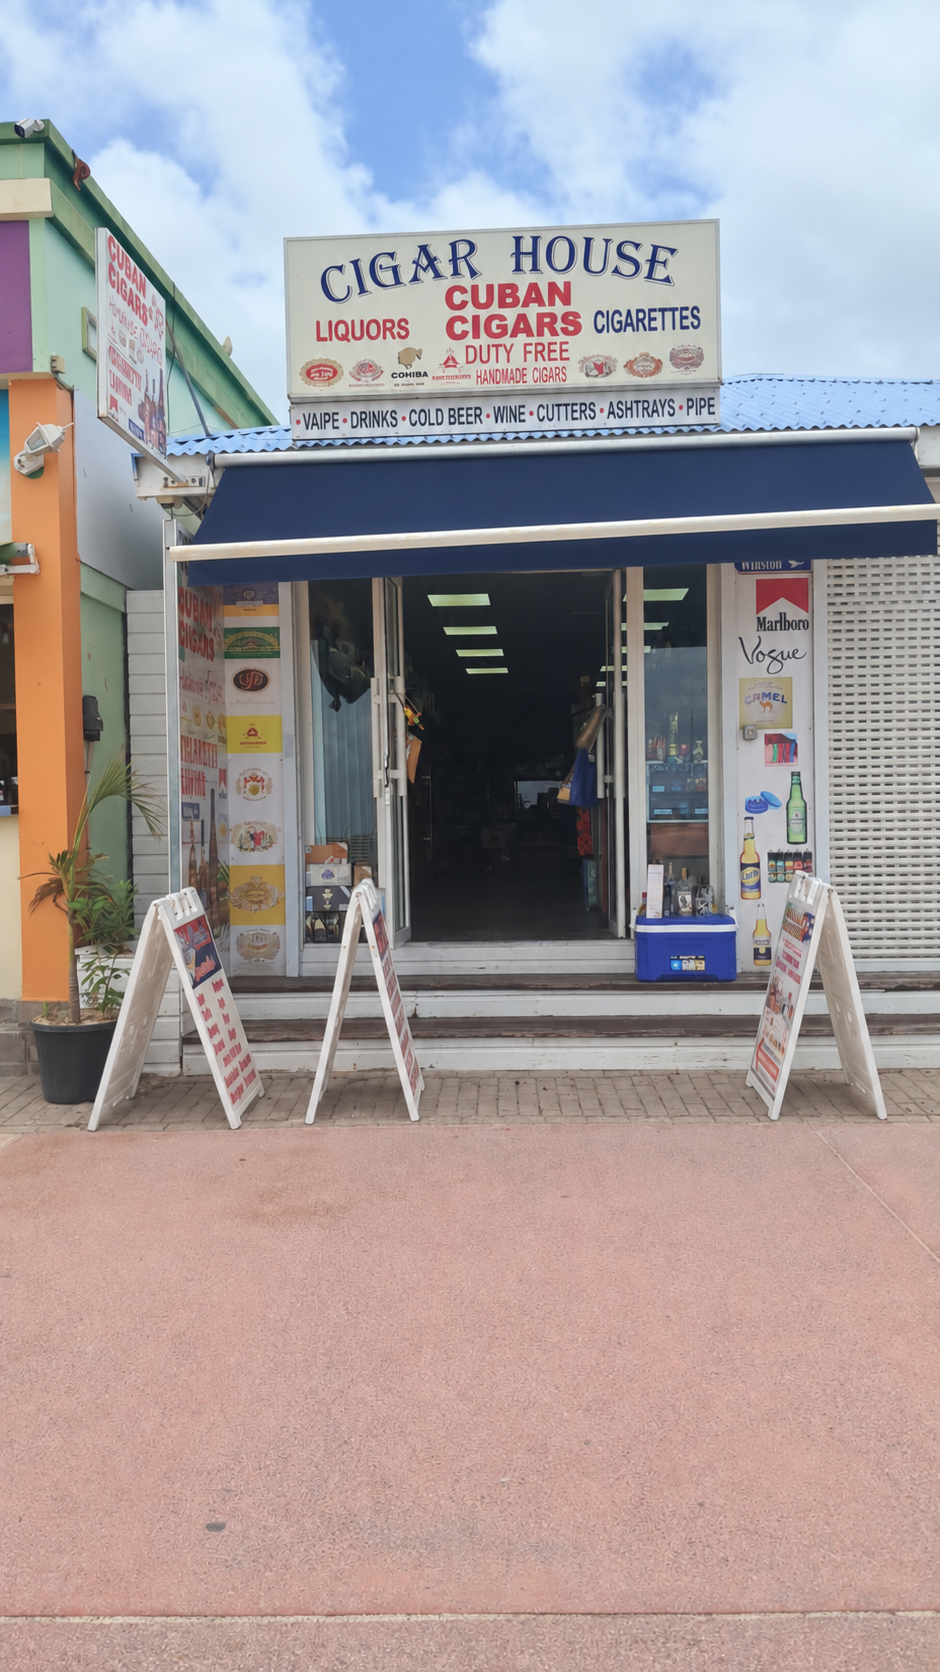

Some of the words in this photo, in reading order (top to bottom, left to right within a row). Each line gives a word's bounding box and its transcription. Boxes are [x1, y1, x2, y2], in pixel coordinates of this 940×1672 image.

[108, 235, 147, 299] CUBAN
[320, 238, 483, 304] CIGAR
[510, 235, 678, 287] HOUSE
[445, 281, 572, 311] CUBAN
[315, 318, 410, 343] LIQUORS
[445, 311, 582, 341] CIGARS
[593, 306, 701, 334] CIGARETTES
[465, 343, 514, 365] DUTY
[523, 341, 570, 362] FREE
[391, 371, 429, 379] COHIBA
[475, 368, 527, 385] HANDMADE
[532, 366, 567, 384] CIGARS
[303, 411, 340, 431] VAIPE
[350, 410, 398, 430] DRINKS
[408, 408, 444, 427] COLD
[448, 407, 483, 425] BEER
[493, 405, 526, 424] WINE
[536, 402, 596, 422] CUTTERS
[607, 399, 676, 420] ASHTRAYS
[685, 397, 716, 416] PIPE
[756, 612, 809, 632] Marlboro
[738, 635, 807, 675] Vogue
[744, 691, 787, 705] CAMEL
